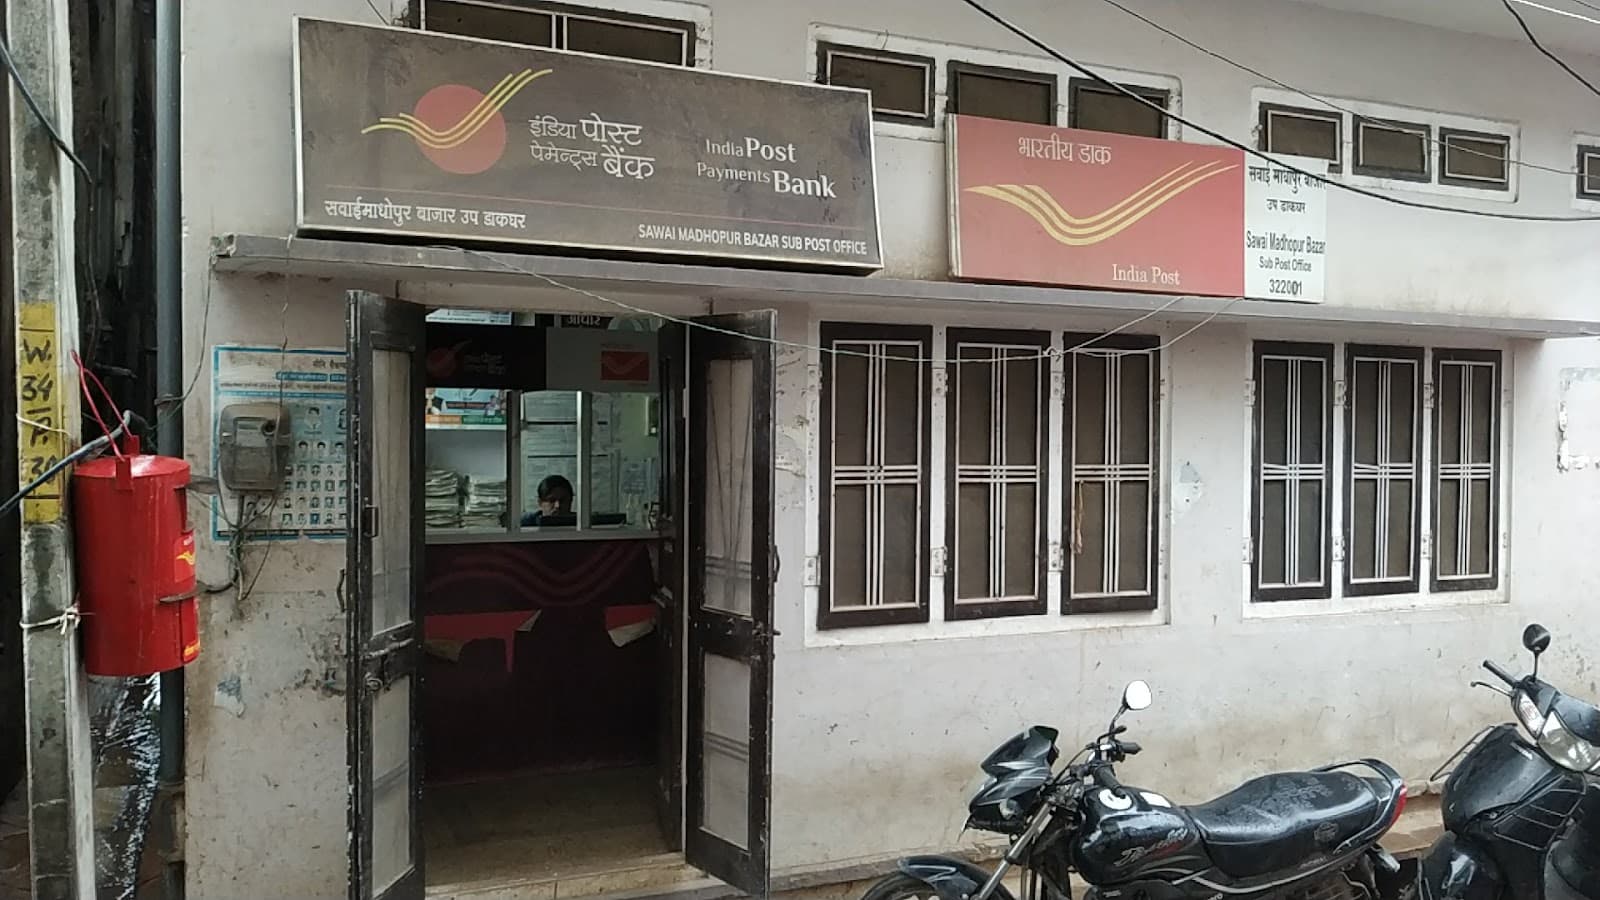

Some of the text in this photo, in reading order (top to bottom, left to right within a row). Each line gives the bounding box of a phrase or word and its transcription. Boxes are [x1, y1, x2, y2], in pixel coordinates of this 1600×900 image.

[527, 112, 643, 146] इंडिया पोस्ट
[529, 140, 656, 180] पेमेन्ट्स बैंक
[706, 136, 798, 163] India Post
[1018, 132, 1112, 165] भारतीय डाक
[696, 161, 837, 199] Payments Bank
[323, 196, 412, 227] सवाईमाधोपुर
[459, 209, 479, 226] उप
[482, 210, 527, 229] डाकघर
[638, 223, 868, 256] SAWAI MADHOPUR BAZAR SUB POST OFFICE
[1246, 230, 1327, 257] Sawai Madhopur Bazar
[1111, 263, 1181, 286] India Post
[1258, 256, 1313, 273] Sub Post Office
[1268, 279, 1303, 297] 322001
